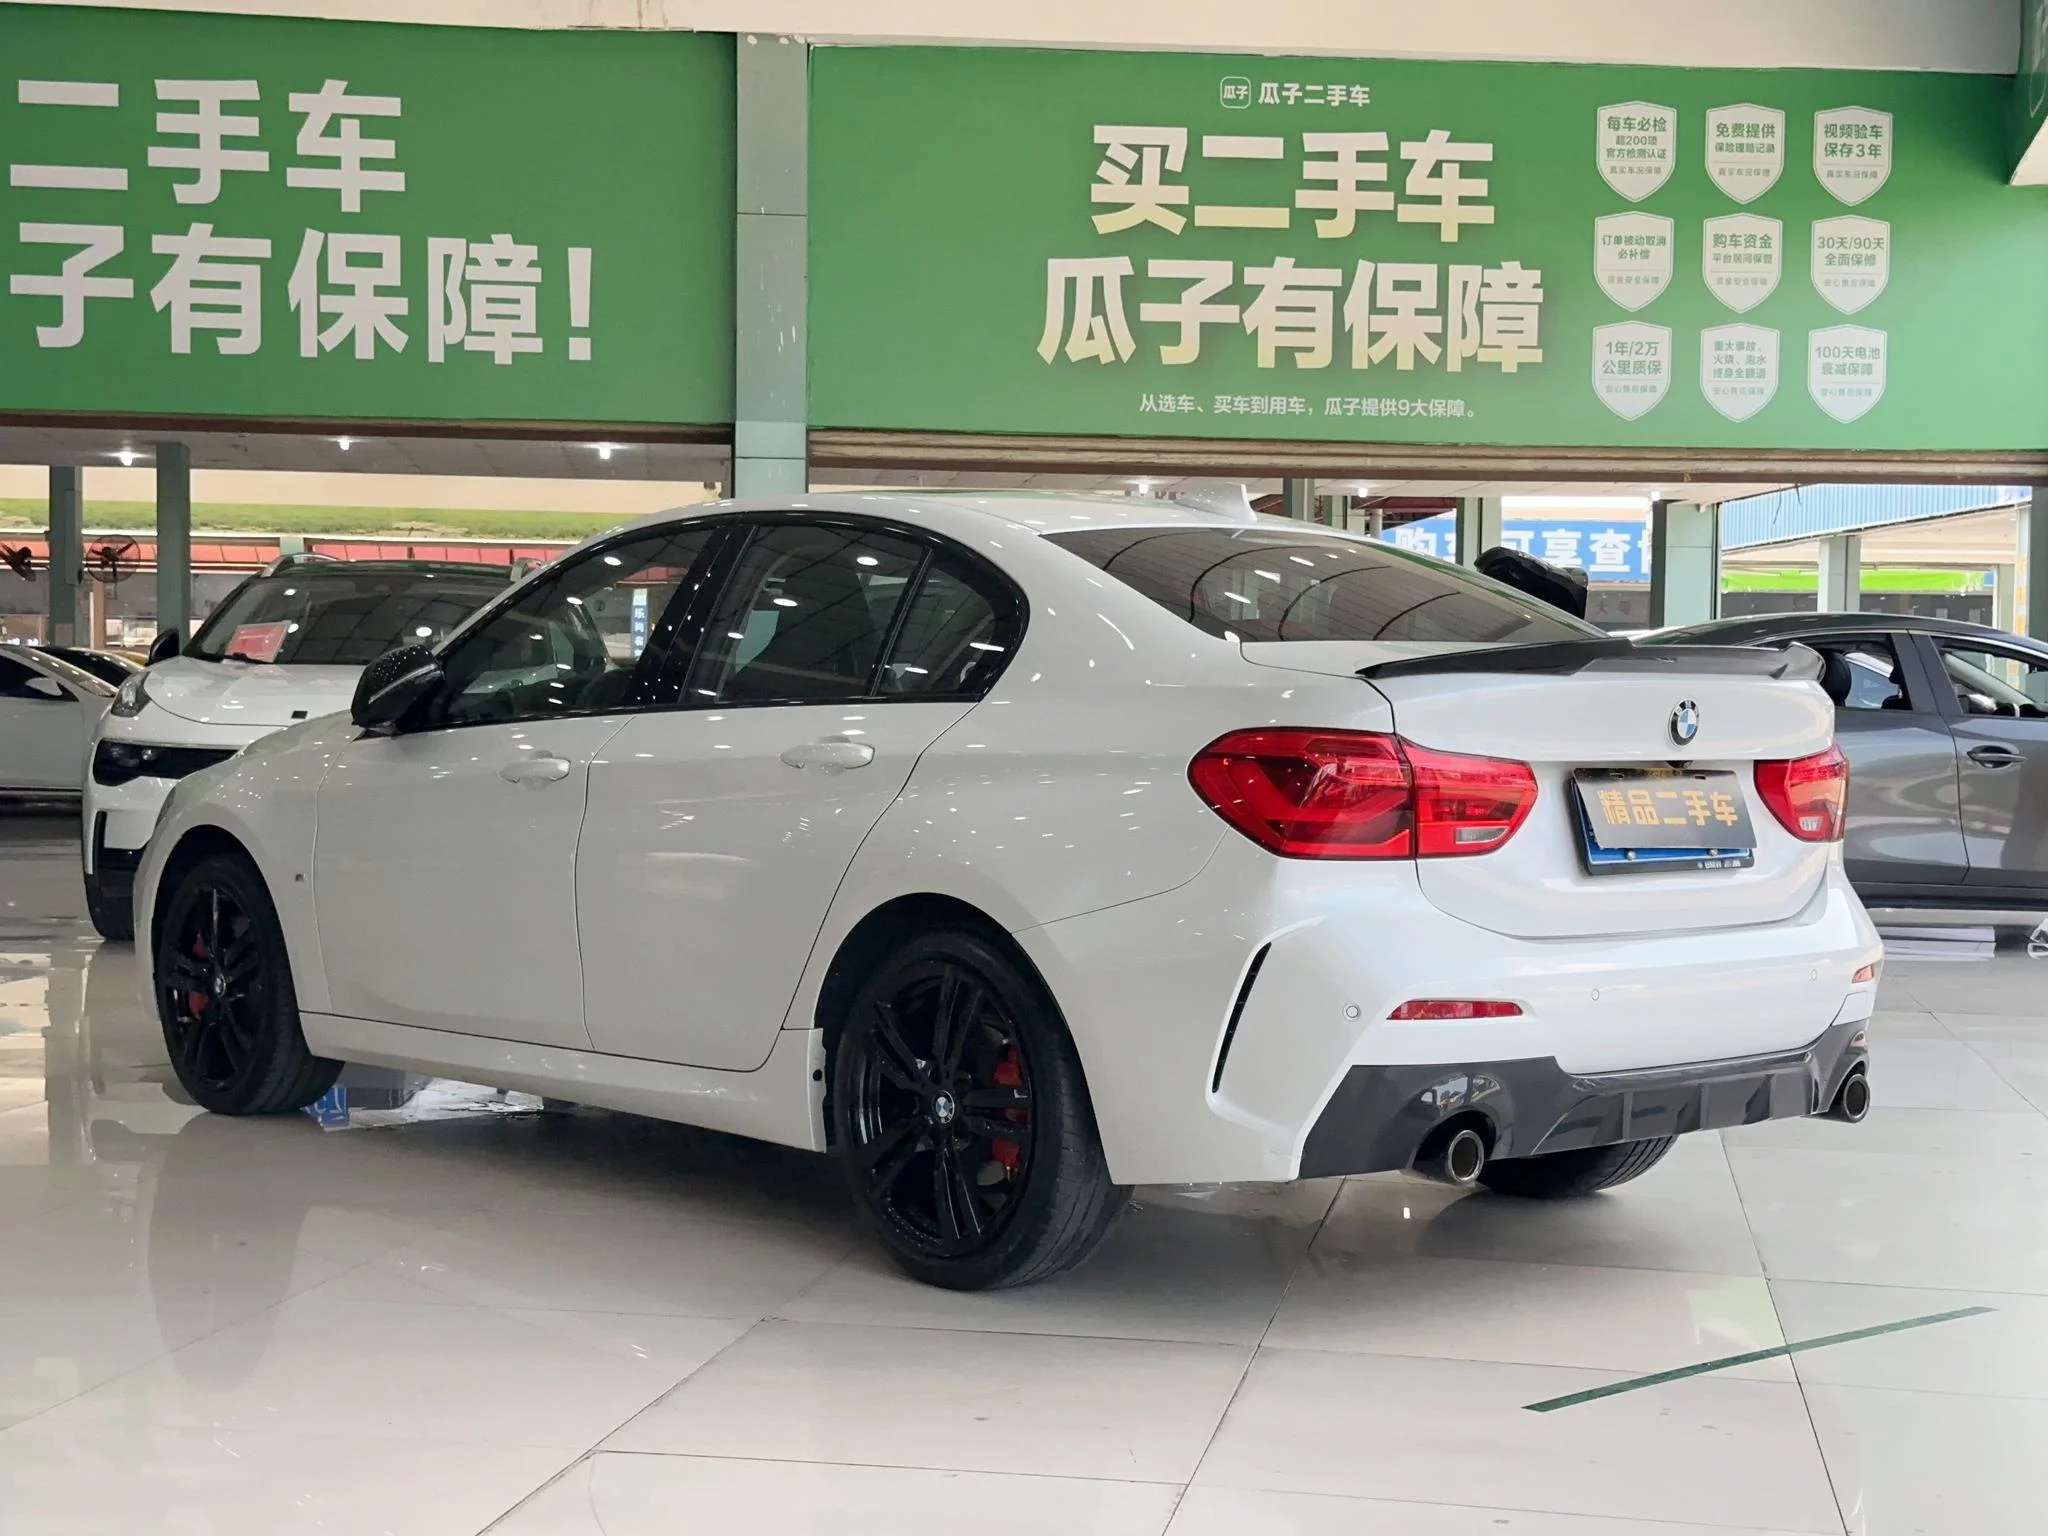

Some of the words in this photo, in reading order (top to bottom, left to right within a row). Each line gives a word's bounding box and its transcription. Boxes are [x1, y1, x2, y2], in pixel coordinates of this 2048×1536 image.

[1223, 85, 1248, 99] 瓜子
[1258, 82, 1370, 107] 瓜子二手车
[1607, 116, 1667, 132] 每车必检
[1716, 122, 1776, 139] 免费提供
[1824, 124, 1883, 140] 视频验车
[10, 78, 405, 213] 二手车
[1824, 142, 1882, 159] 保存3年
[1090, 124, 1495, 242] 买二手车
[1713, 233, 1773, 249] 购车资金
[1817, 236, 1885, 250] 30天/90天
[1824, 252, 1876, 267] 全面保修
[1037, 256, 1543, 373] 瓜子有保障
[1605, 340, 1660, 356] 1年/2万
[1815, 346, 1881, 360] 100天电池
[1602, 360, 1662, 375] 公里质保
[1596, 788, 1739, 827] 精品二手车
